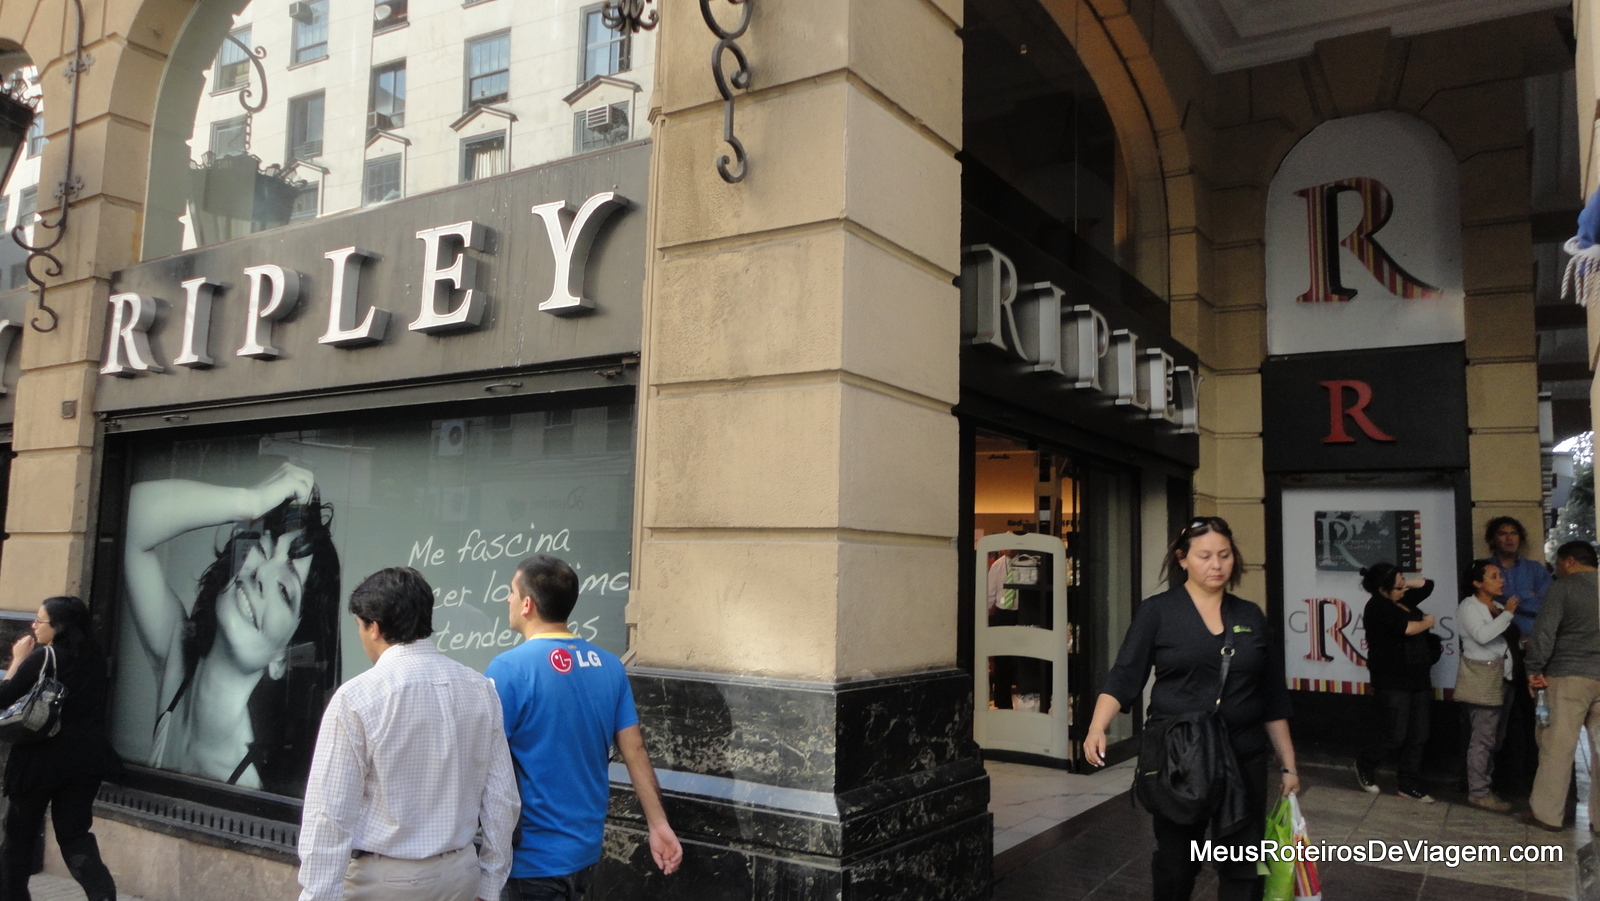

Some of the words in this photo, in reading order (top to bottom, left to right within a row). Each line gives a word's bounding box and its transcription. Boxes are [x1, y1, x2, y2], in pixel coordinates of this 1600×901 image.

[100, 191, 628, 378] RIPLEY
[970, 243, 1205, 435] RIPLEY
[1317, 378, 1398, 444] R
[407, 536, 446, 568] Me
[458, 522, 571, 563] fascina
[1401, 515, 1411, 568] RIPLEY
[483, 569, 512, 603] lo
[575, 650, 602, 667] LG
